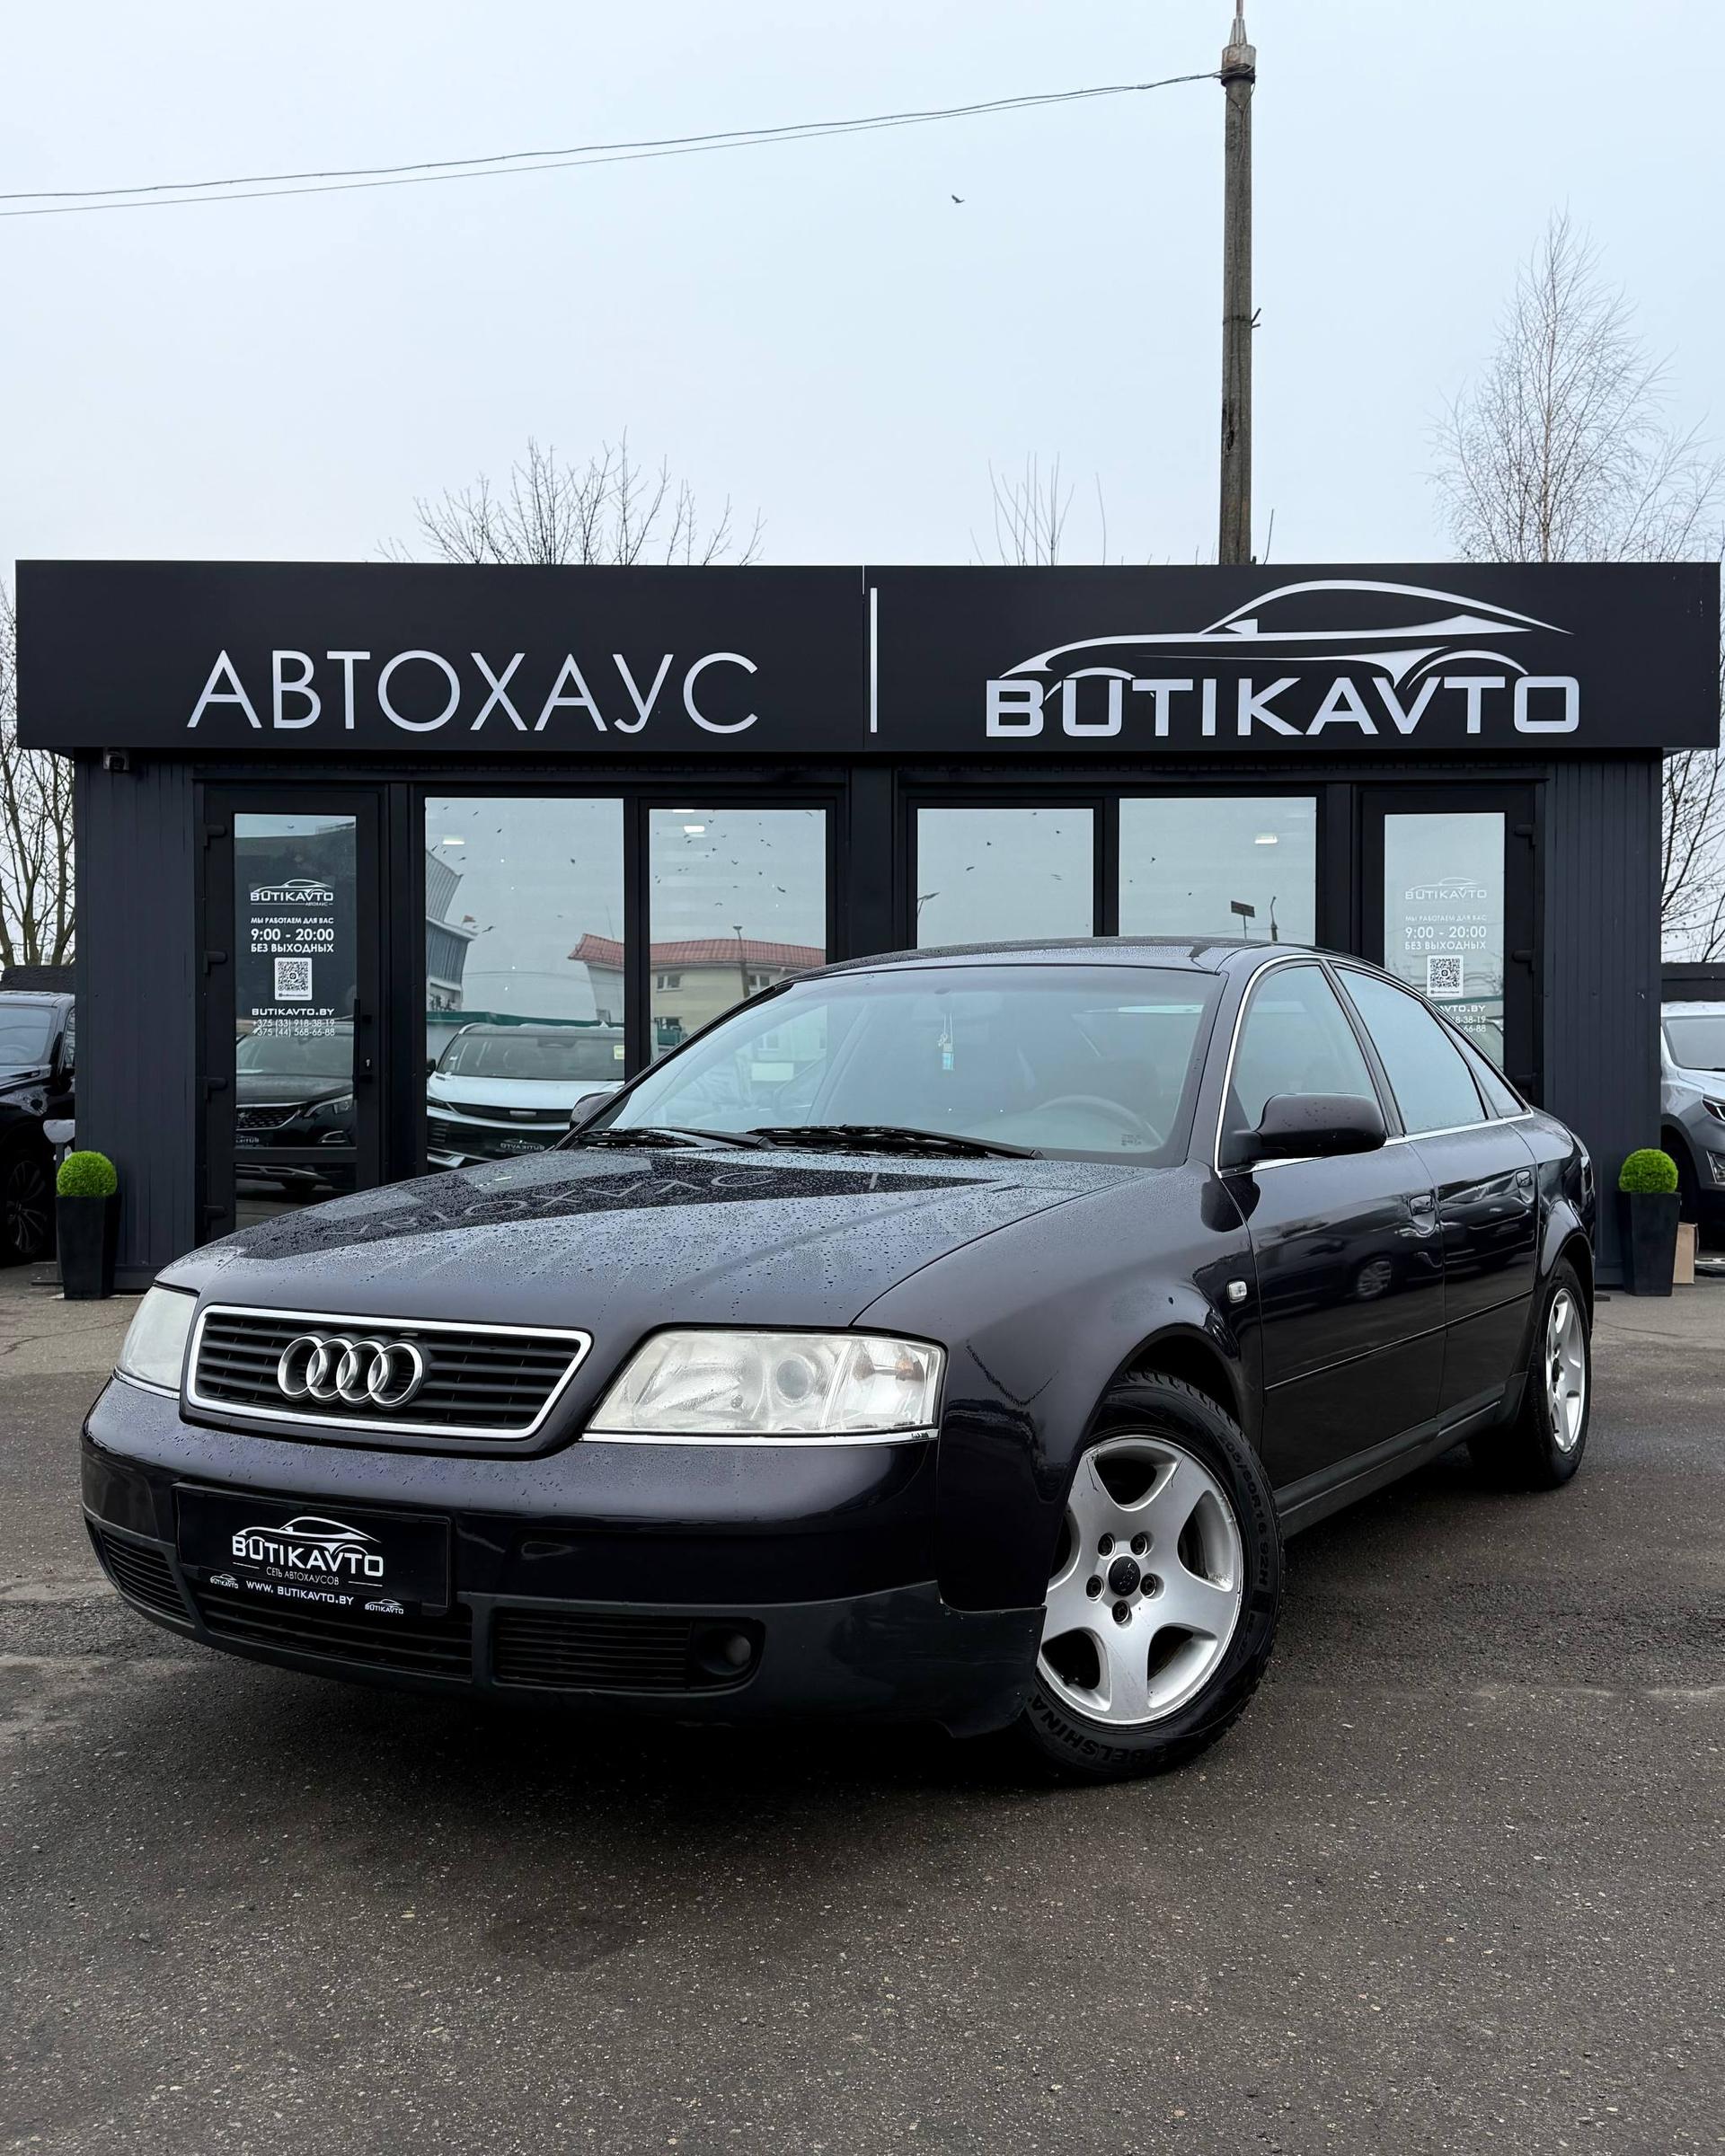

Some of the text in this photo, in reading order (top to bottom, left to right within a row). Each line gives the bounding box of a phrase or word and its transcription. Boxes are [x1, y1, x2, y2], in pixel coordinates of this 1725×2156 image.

[187, 649, 758, 734] АВТОХАУС
[986, 676, 1579, 737] BUTIKAVTO
[250, 891, 334, 901] BUTIKAVTO
[1405, 889, 1488, 899] BUTIKAVTO
[251, 928, 281, 941] 9:00
[295, 928, 334, 941] 20:00
[1405, 926, 1434, 939] 9:00
[1448, 925, 1487, 938] 20:00
[251, 943, 334, 954] БЕЗ ВЫХОДНЫХ
[1404, 941, 1487, 950] БЕЗ ВЫХОДНЫХ
[252, 1008, 335, 1016] BUTIKAVTO.BY
[253, 1028, 335, 1038] 375 (44) 568-66-88
[232, 1535, 384, 1577] BUTIKAVTO
[266, 1566, 340, 1586] СЕТЬ АВТОХАУСОВ
[277, 1586, 355, 1605] BUTIKAVTO.BY
